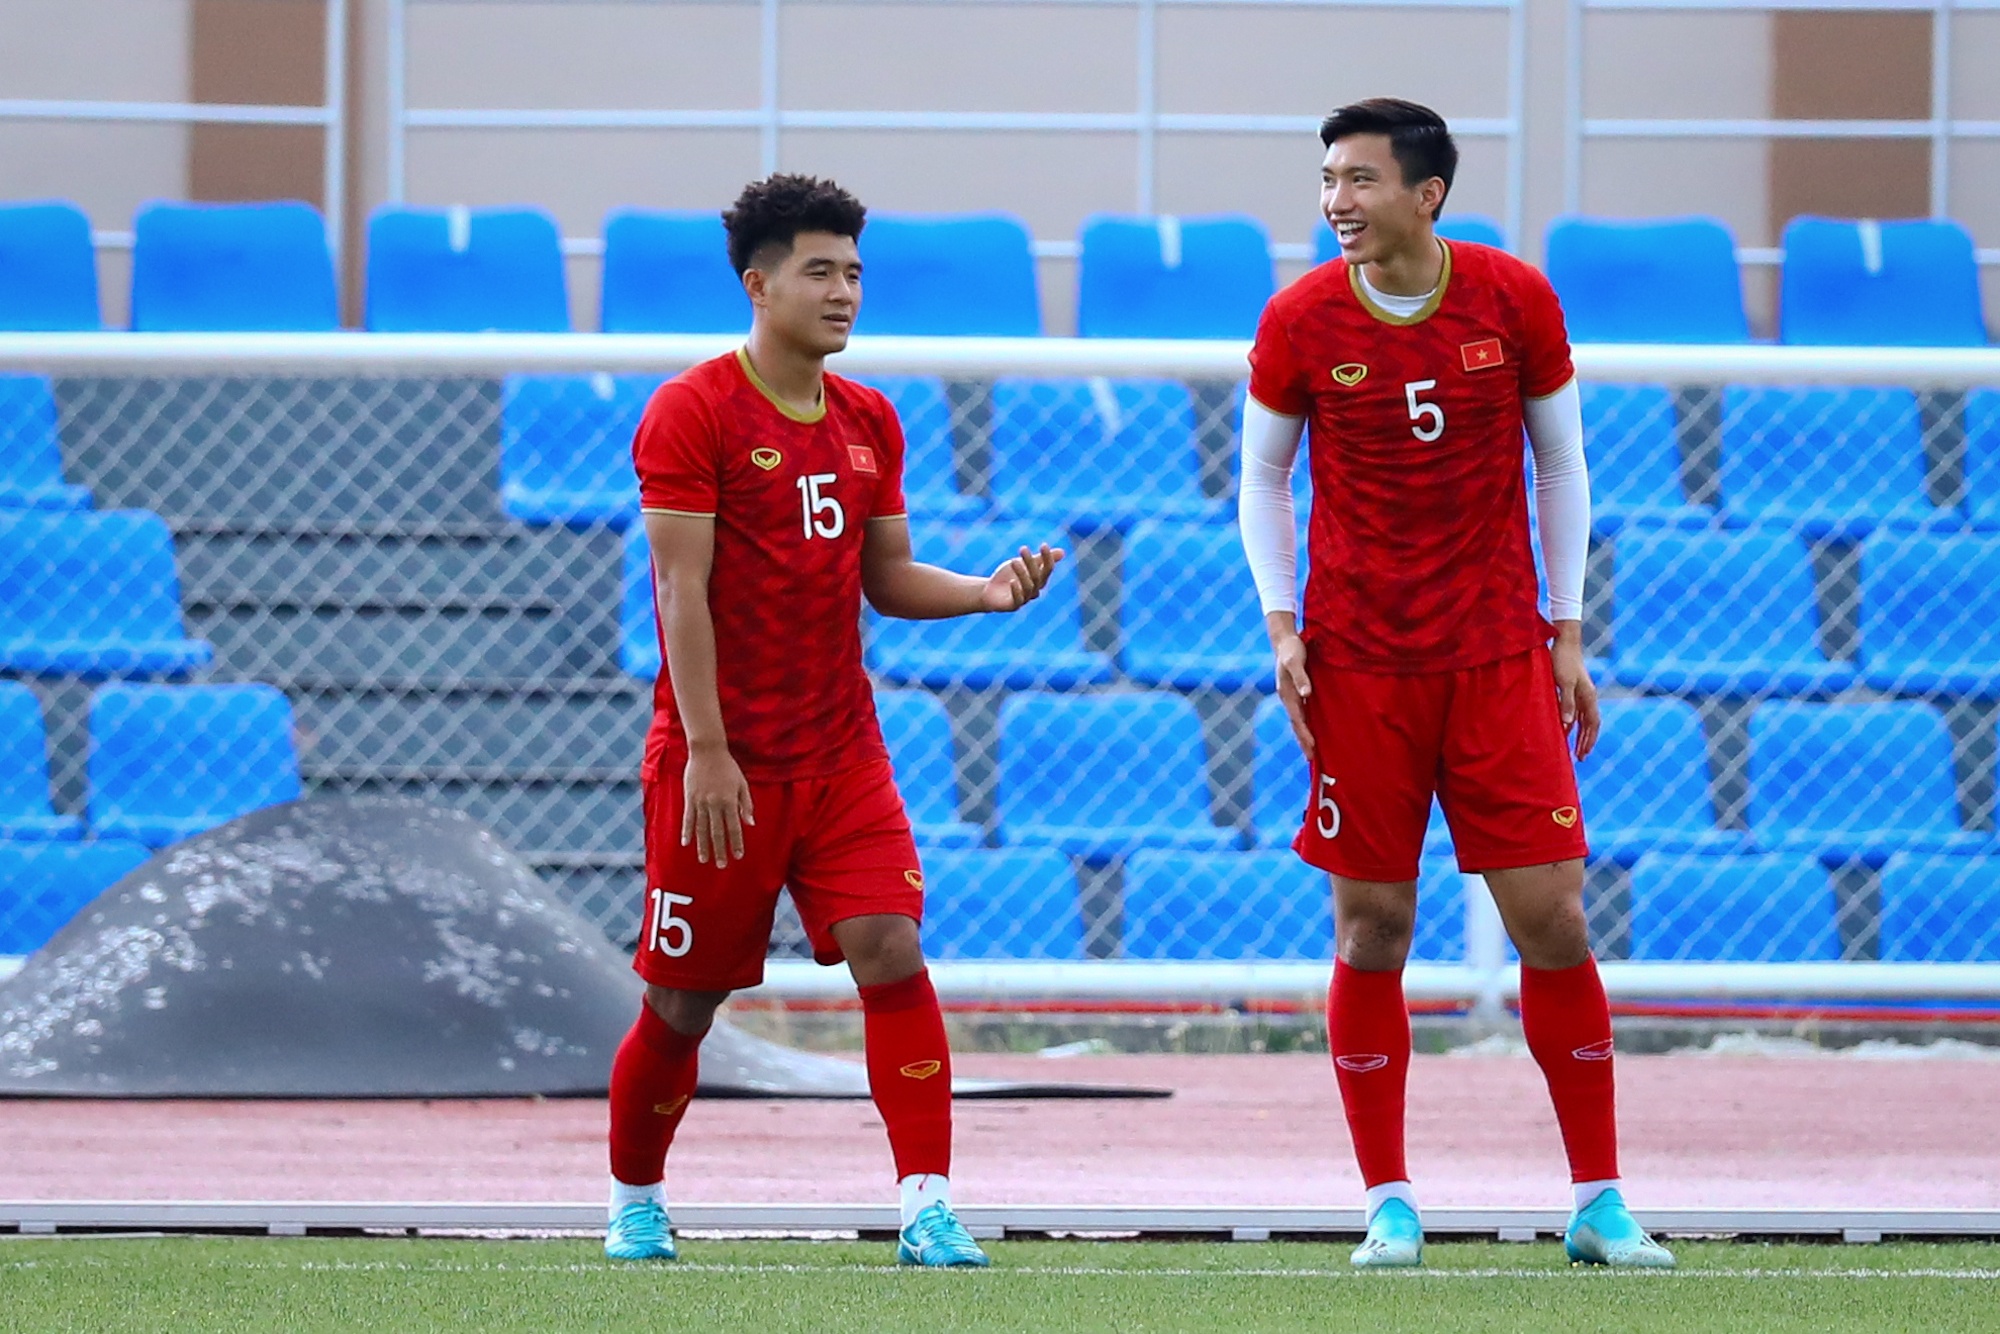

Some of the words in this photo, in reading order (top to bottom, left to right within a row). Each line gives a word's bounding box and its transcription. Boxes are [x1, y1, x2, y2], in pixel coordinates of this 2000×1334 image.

[1405, 379, 1445, 442] 5
[796, 473, 845, 540] 15
[1317, 773, 1341, 839] 5
[649, 888, 693, 957] 15
